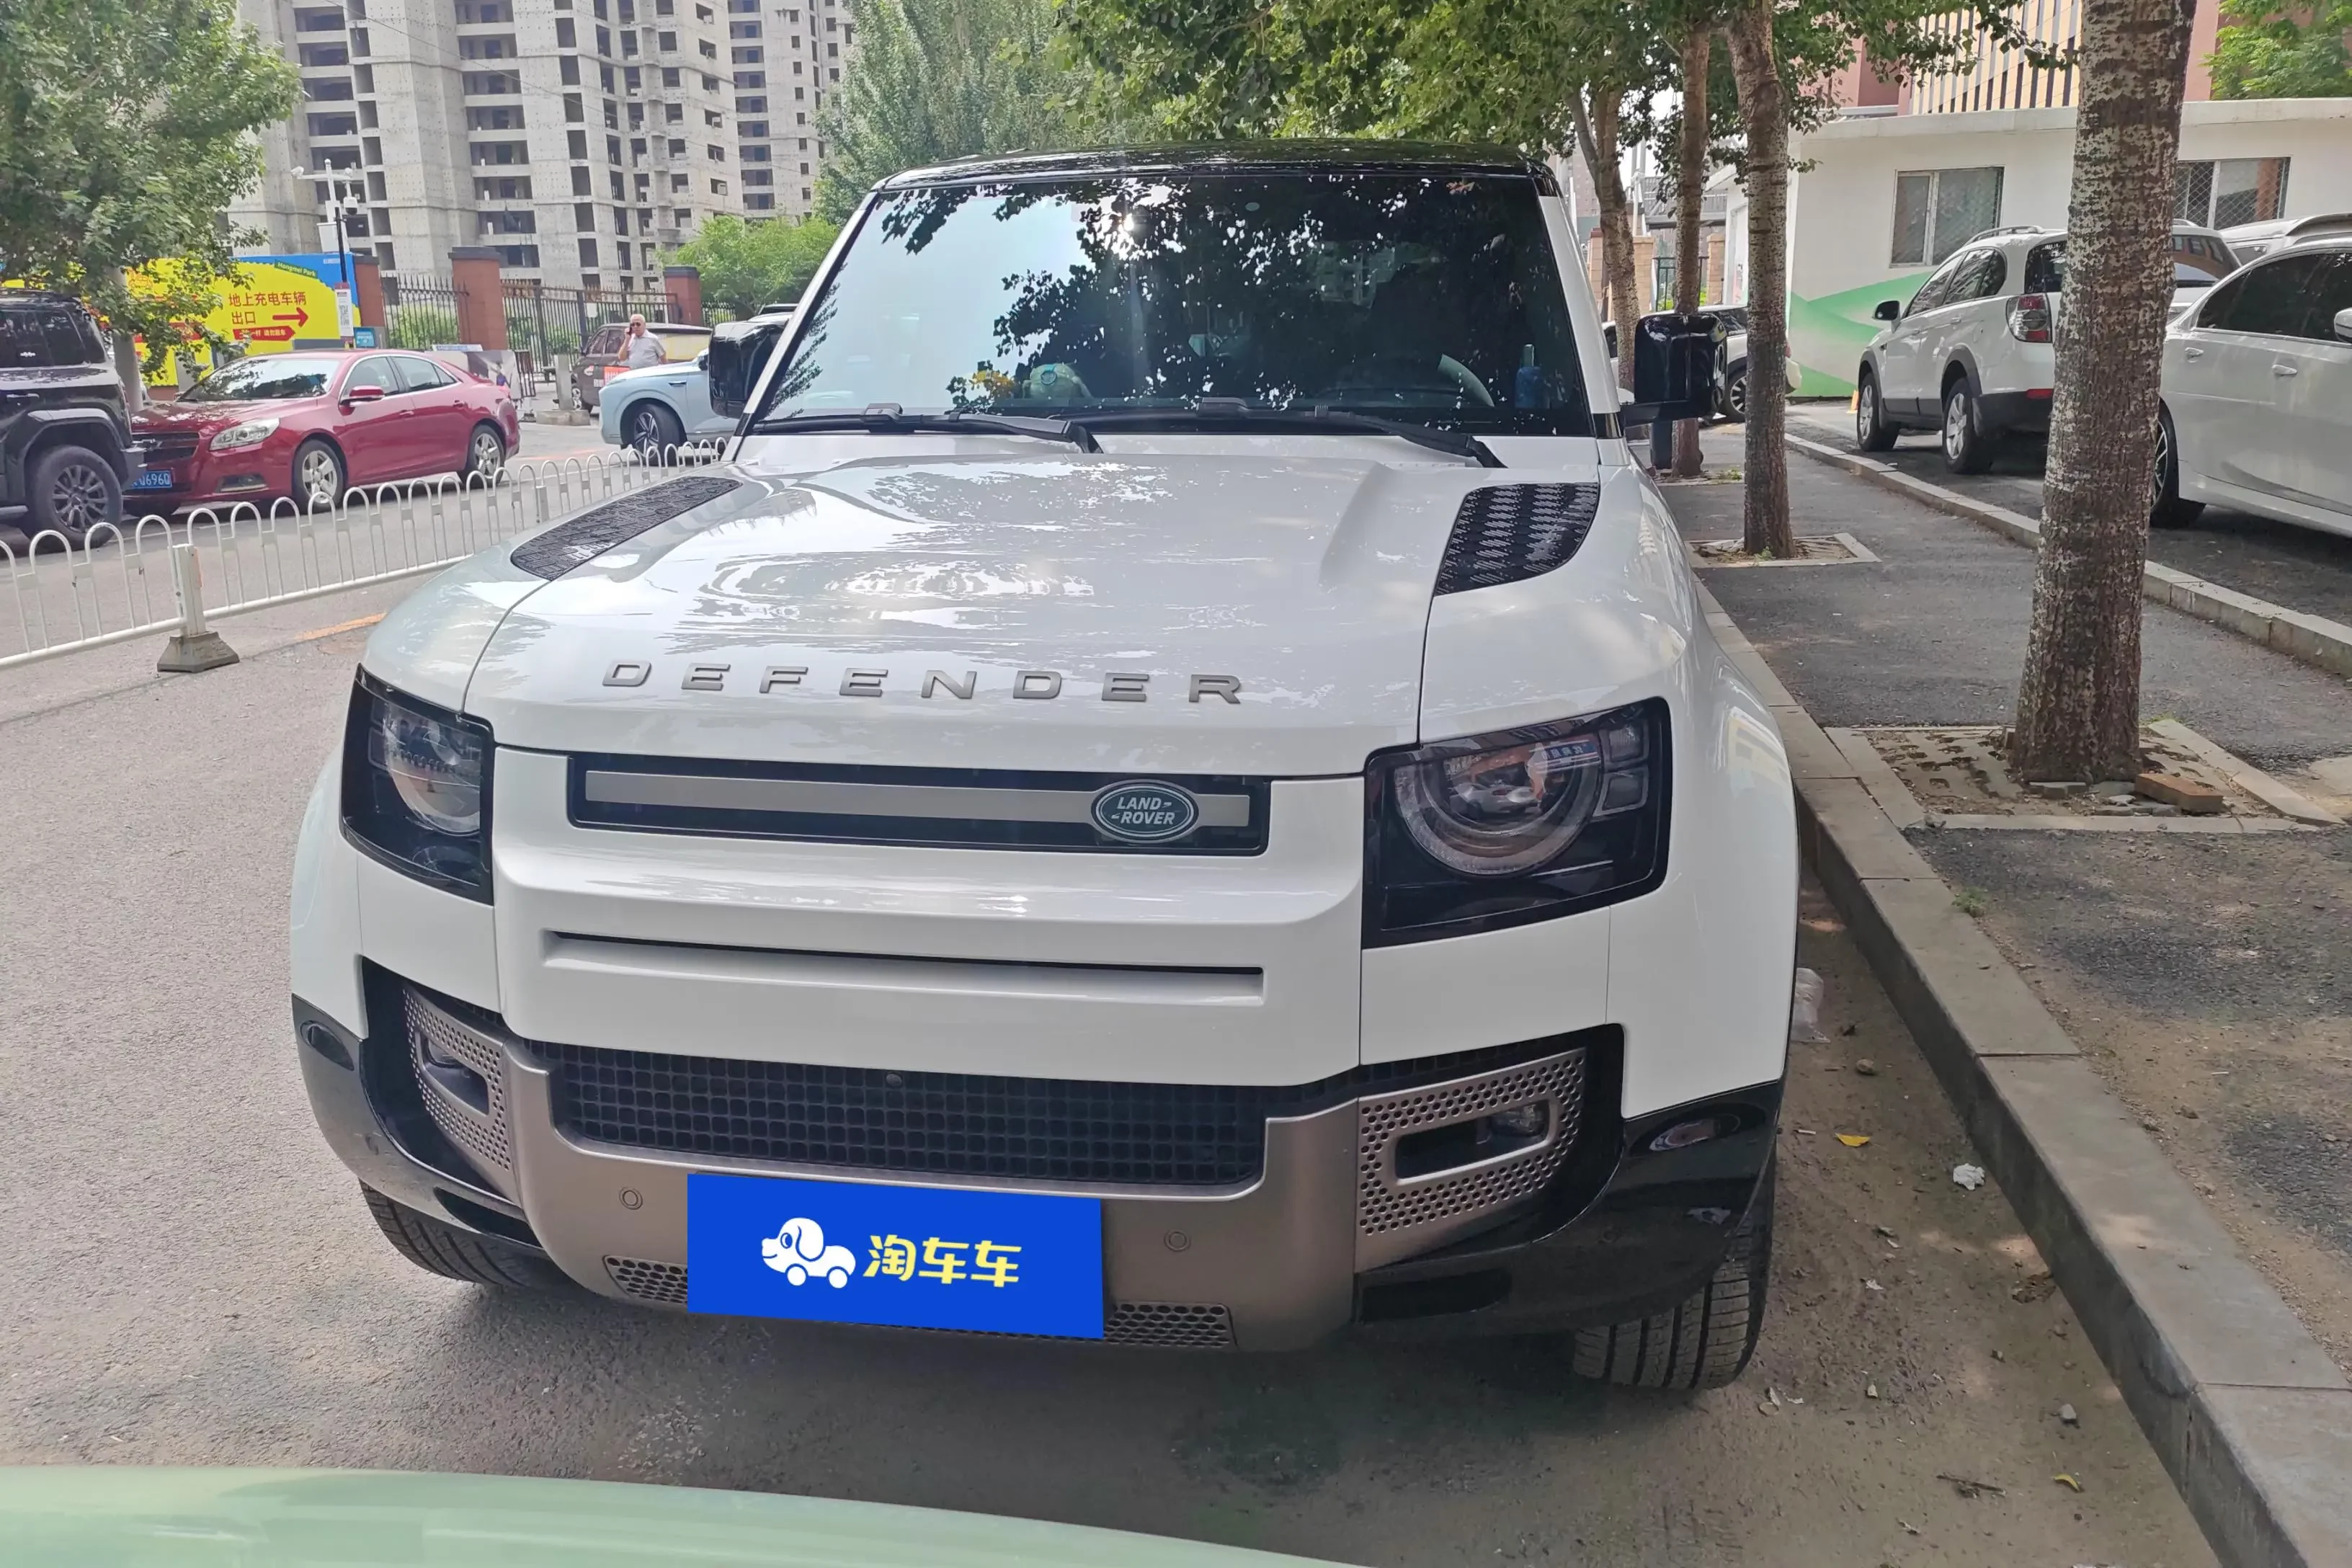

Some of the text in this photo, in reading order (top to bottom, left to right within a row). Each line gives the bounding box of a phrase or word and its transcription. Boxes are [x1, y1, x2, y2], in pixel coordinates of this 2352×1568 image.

[303, 268, 316, 277] Park
[228, 291, 306, 307] 地上充电车辆
[231, 311, 256, 324] 出口
[602, 660, 1241, 704] DEFENDER
[1117, 797, 1162, 810] LAND
[1120, 811, 1175, 825] ROVER
